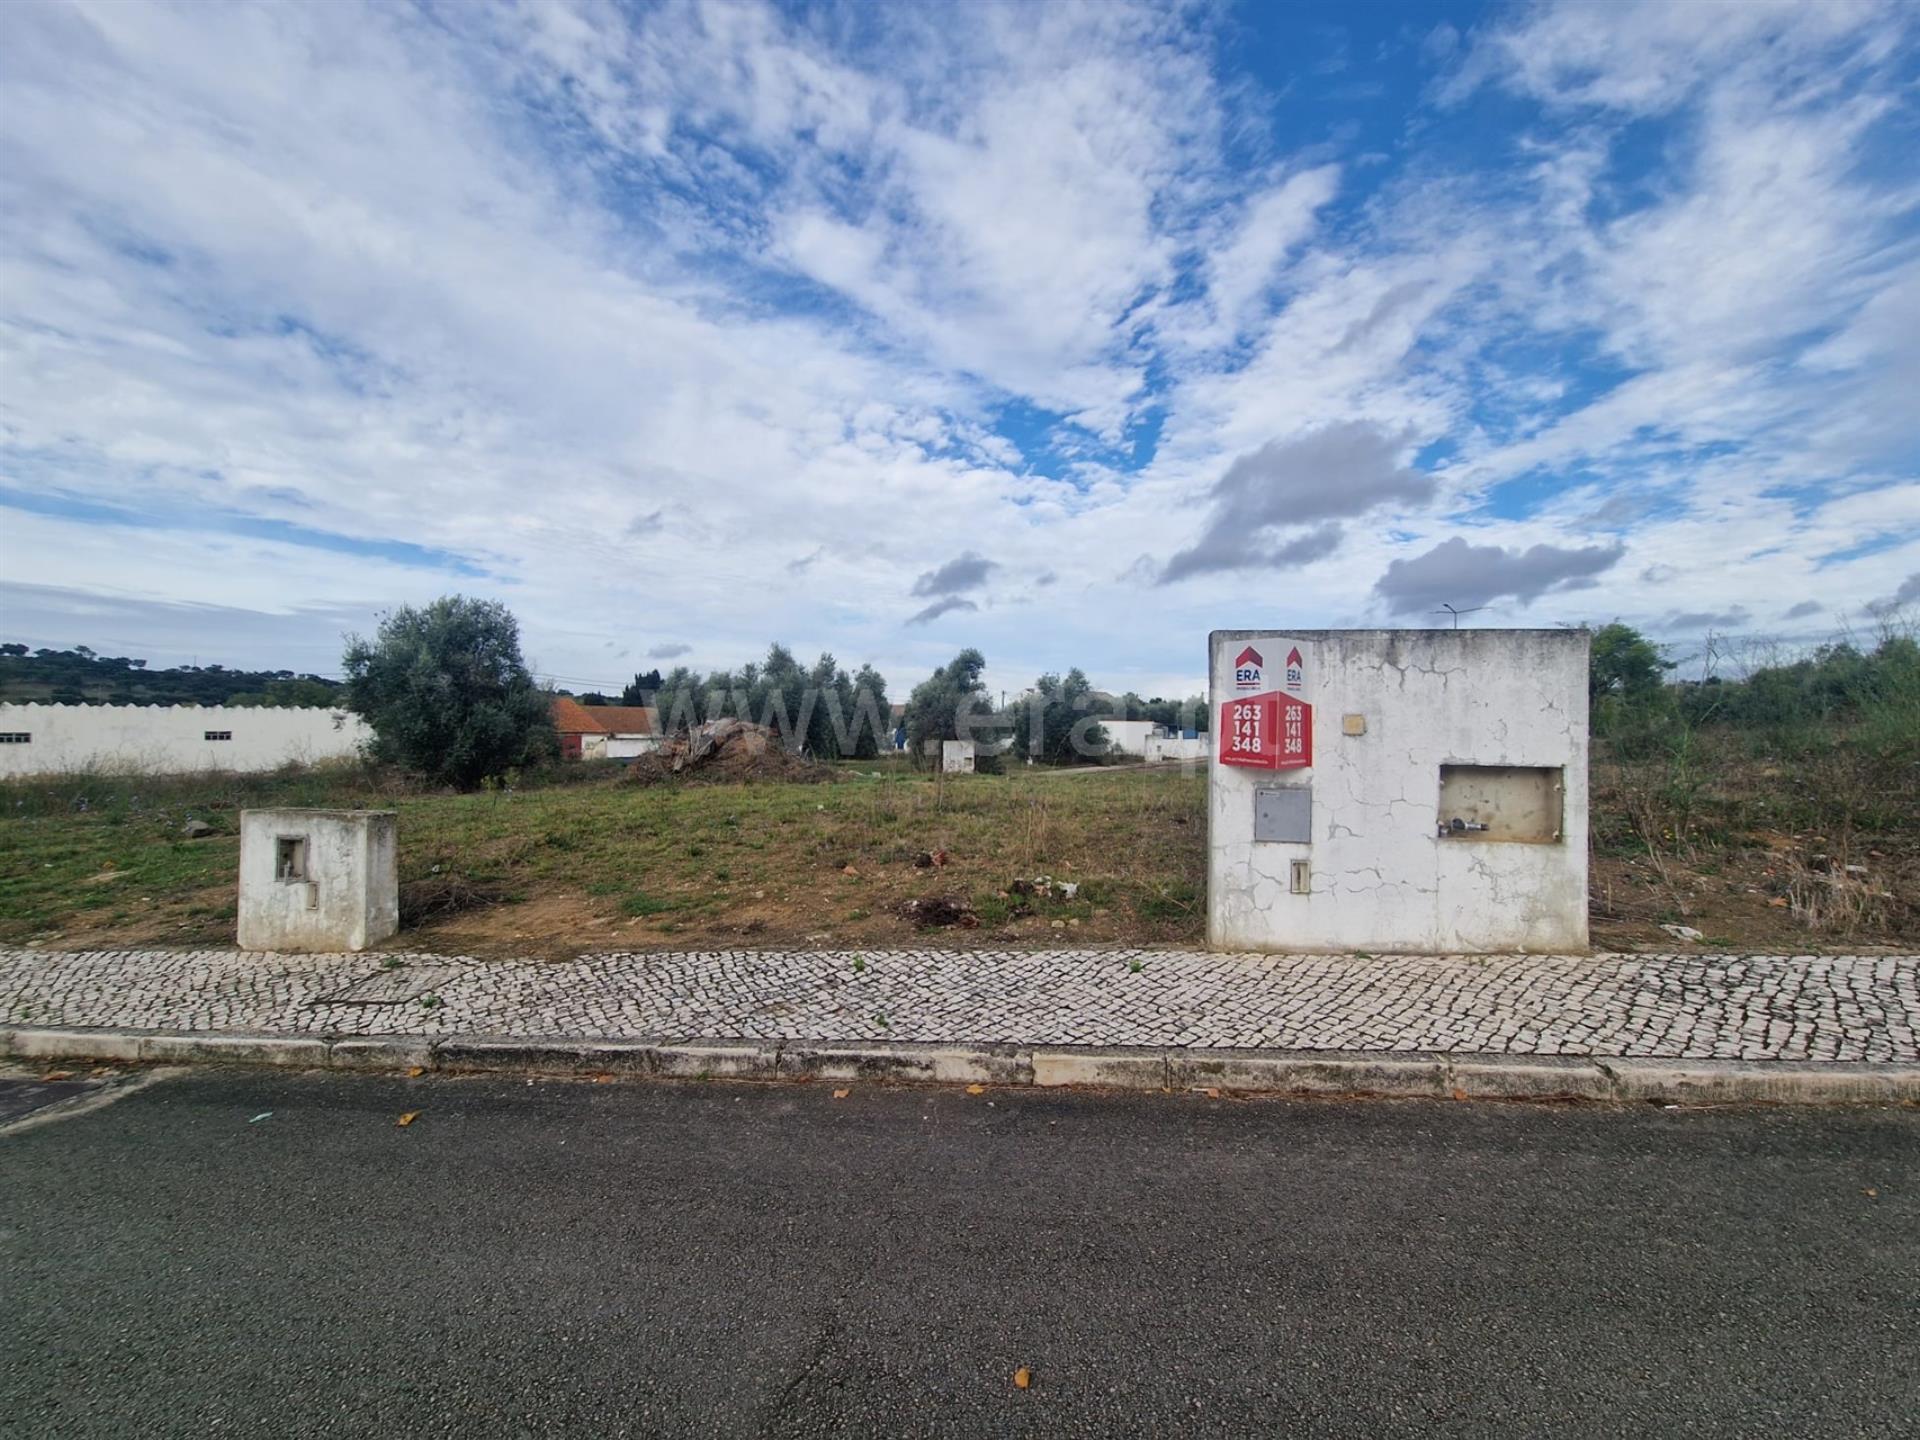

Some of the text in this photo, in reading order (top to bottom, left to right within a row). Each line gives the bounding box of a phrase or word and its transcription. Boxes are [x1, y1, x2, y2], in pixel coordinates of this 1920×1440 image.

[1236, 669, 1261, 681] ERA
[1287, 669, 1301, 682] ERA
[1233, 705, 1261, 721] 263
[1285, 705, 1302, 721] 263
[1234, 721, 1260, 737] 141
[1286, 722, 1301, 737] 141
[1232, 737, 1261, 753] 348
[1284, 738, 1302, 754] 348
